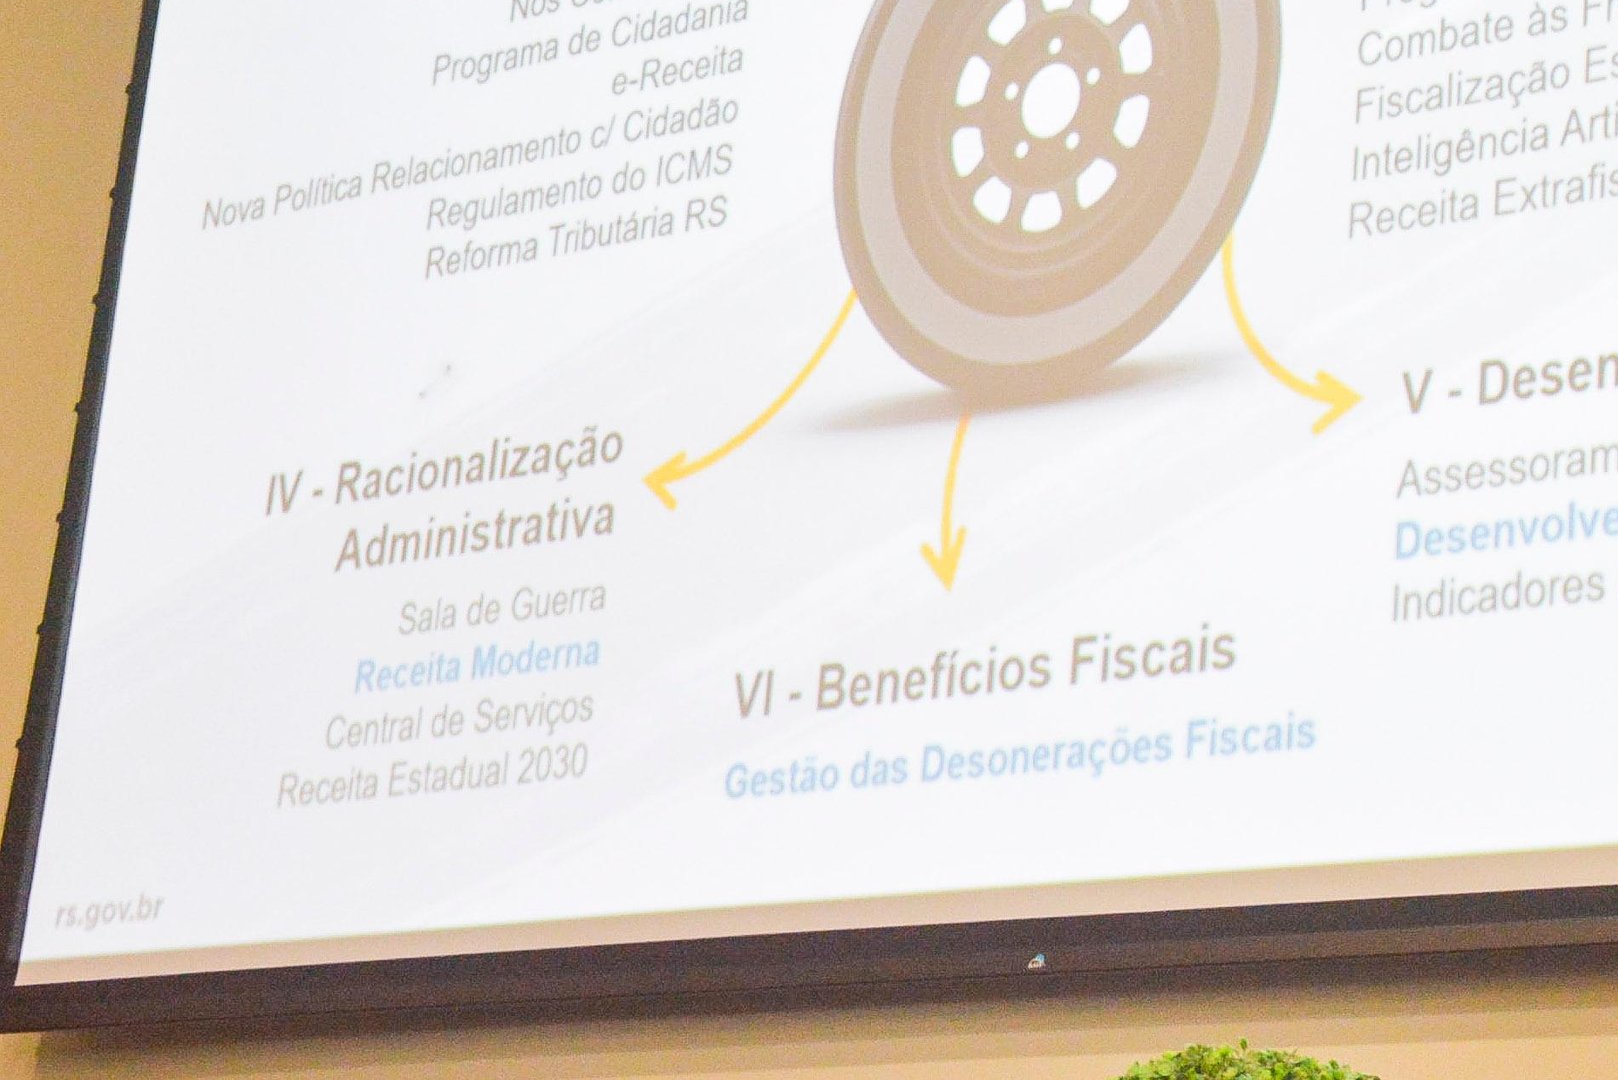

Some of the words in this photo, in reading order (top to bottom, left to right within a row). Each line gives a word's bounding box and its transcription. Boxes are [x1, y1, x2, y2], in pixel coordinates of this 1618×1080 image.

[432, 37, 560, 86] Programa
[567, 23, 602, 56] de
[1357, 11, 1514, 67] Combate
[1527, 1, 1569, 37] às
[611, 45, 745, 96] e-Receita
[1355, 60, 1571, 124] Fiscalização
[202, 196, 266, 230] Nova
[273, 173, 363, 216] Política
[370, 127, 583, 194] Relacionamento
[590, 114, 613, 150] c/
[623, 97, 739, 143] Cidadão
[1352, 117, 1551, 182] Inteligência
[426, 171, 604, 232] Regulamento
[611, 161, 648, 195] do
[656, 142, 733, 188] ICMS
[1348, 188, 1480, 240] Receita
[425, 237, 540, 280] Reforma
[549, 206, 676, 257] Tributária
[684, 194, 728, 233] RS
[1402, 368, 1433, 414] V
[1448, 389, 1462, 398] -
[266, 470, 304, 516] IV
[312, 488, 324, 497] -
[335, 425, 623, 505] Racionalização
[335, 502, 615, 572] Administrativa
[398, 597, 458, 636] Sala
[465, 592, 502, 627] de
[511, 584, 607, 622] Guerra
[1392, 569, 1606, 623] Indicadores
[354, 652, 462, 694] Receita
[471, 639, 601, 680] Moderna
[735, 669, 774, 719] VI
[789, 691, 802, 701] -
[816, 647, 1051, 712] Benefícios
[1070, 622, 1236, 685] Fiscais
[325, 706, 424, 751] Central
[430, 703, 466, 739] de
[473, 694, 594, 737] Serviços
[276, 767, 379, 808] Receita
[387, 755, 510, 798] Estadual
[516, 741, 589, 786] 2030
[724, 755, 842, 800] Gestão
[849, 750, 909, 789] das
[920, 727, 1174, 783] Desonerações
[1185, 711, 1317, 760] Fiscais
[54, 892, 164, 932] rs.gov.br
